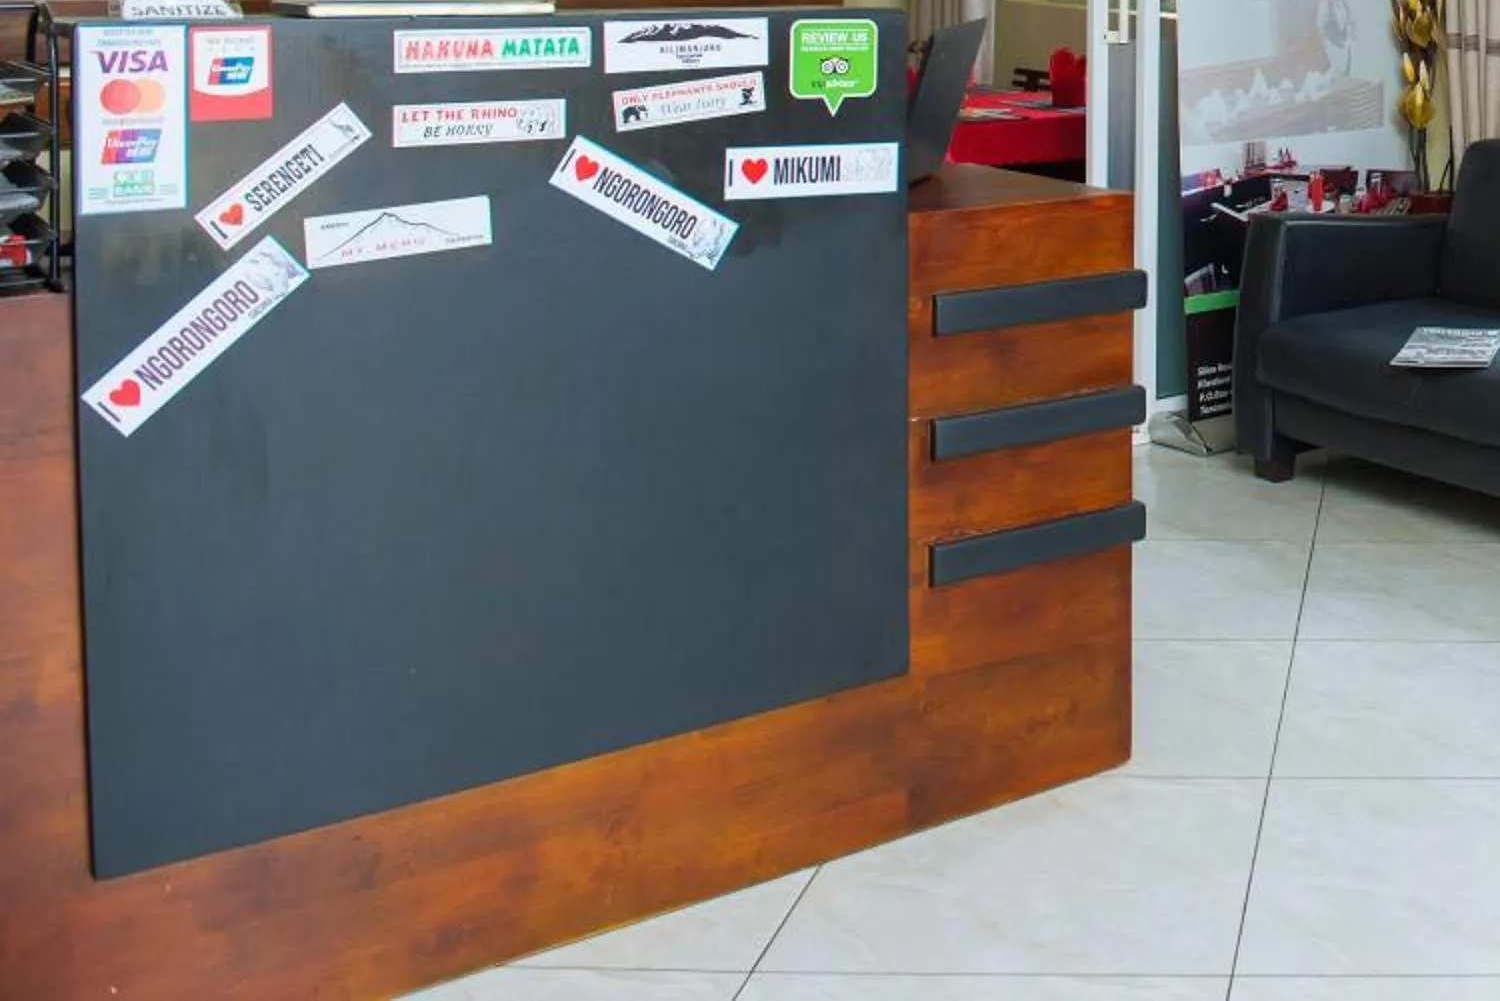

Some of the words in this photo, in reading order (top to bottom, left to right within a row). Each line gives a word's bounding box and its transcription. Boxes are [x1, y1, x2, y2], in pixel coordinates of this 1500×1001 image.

[131, 5, 228, 16] SANITIZE
[405, 39, 494, 61] HAKUNA
[502, 37, 580, 57] MATATA
[801, 31, 849, 45] REVIEW
[95, 50, 169, 74] VISA
[621, 93, 650, 105] ONLY
[651, 85, 713, 102] ELEPHANTS
[402, 110, 429, 123] LET
[436, 108, 465, 121] THE
[471, 106, 518, 120] RHINO
[423, 126, 442, 139] BE
[445, 124, 494, 137] HORNY
[728, 158, 734, 188] I
[773, 154, 842, 186] MIKUMI
[210, 220, 228, 240] I
[244, 143, 326, 212] SERENGETI
[561, 148, 577, 172] I
[592, 166, 698, 240] NGORONGORO
[96, 400, 121, 424] I
[132, 279, 260, 392] NGORONGORO
